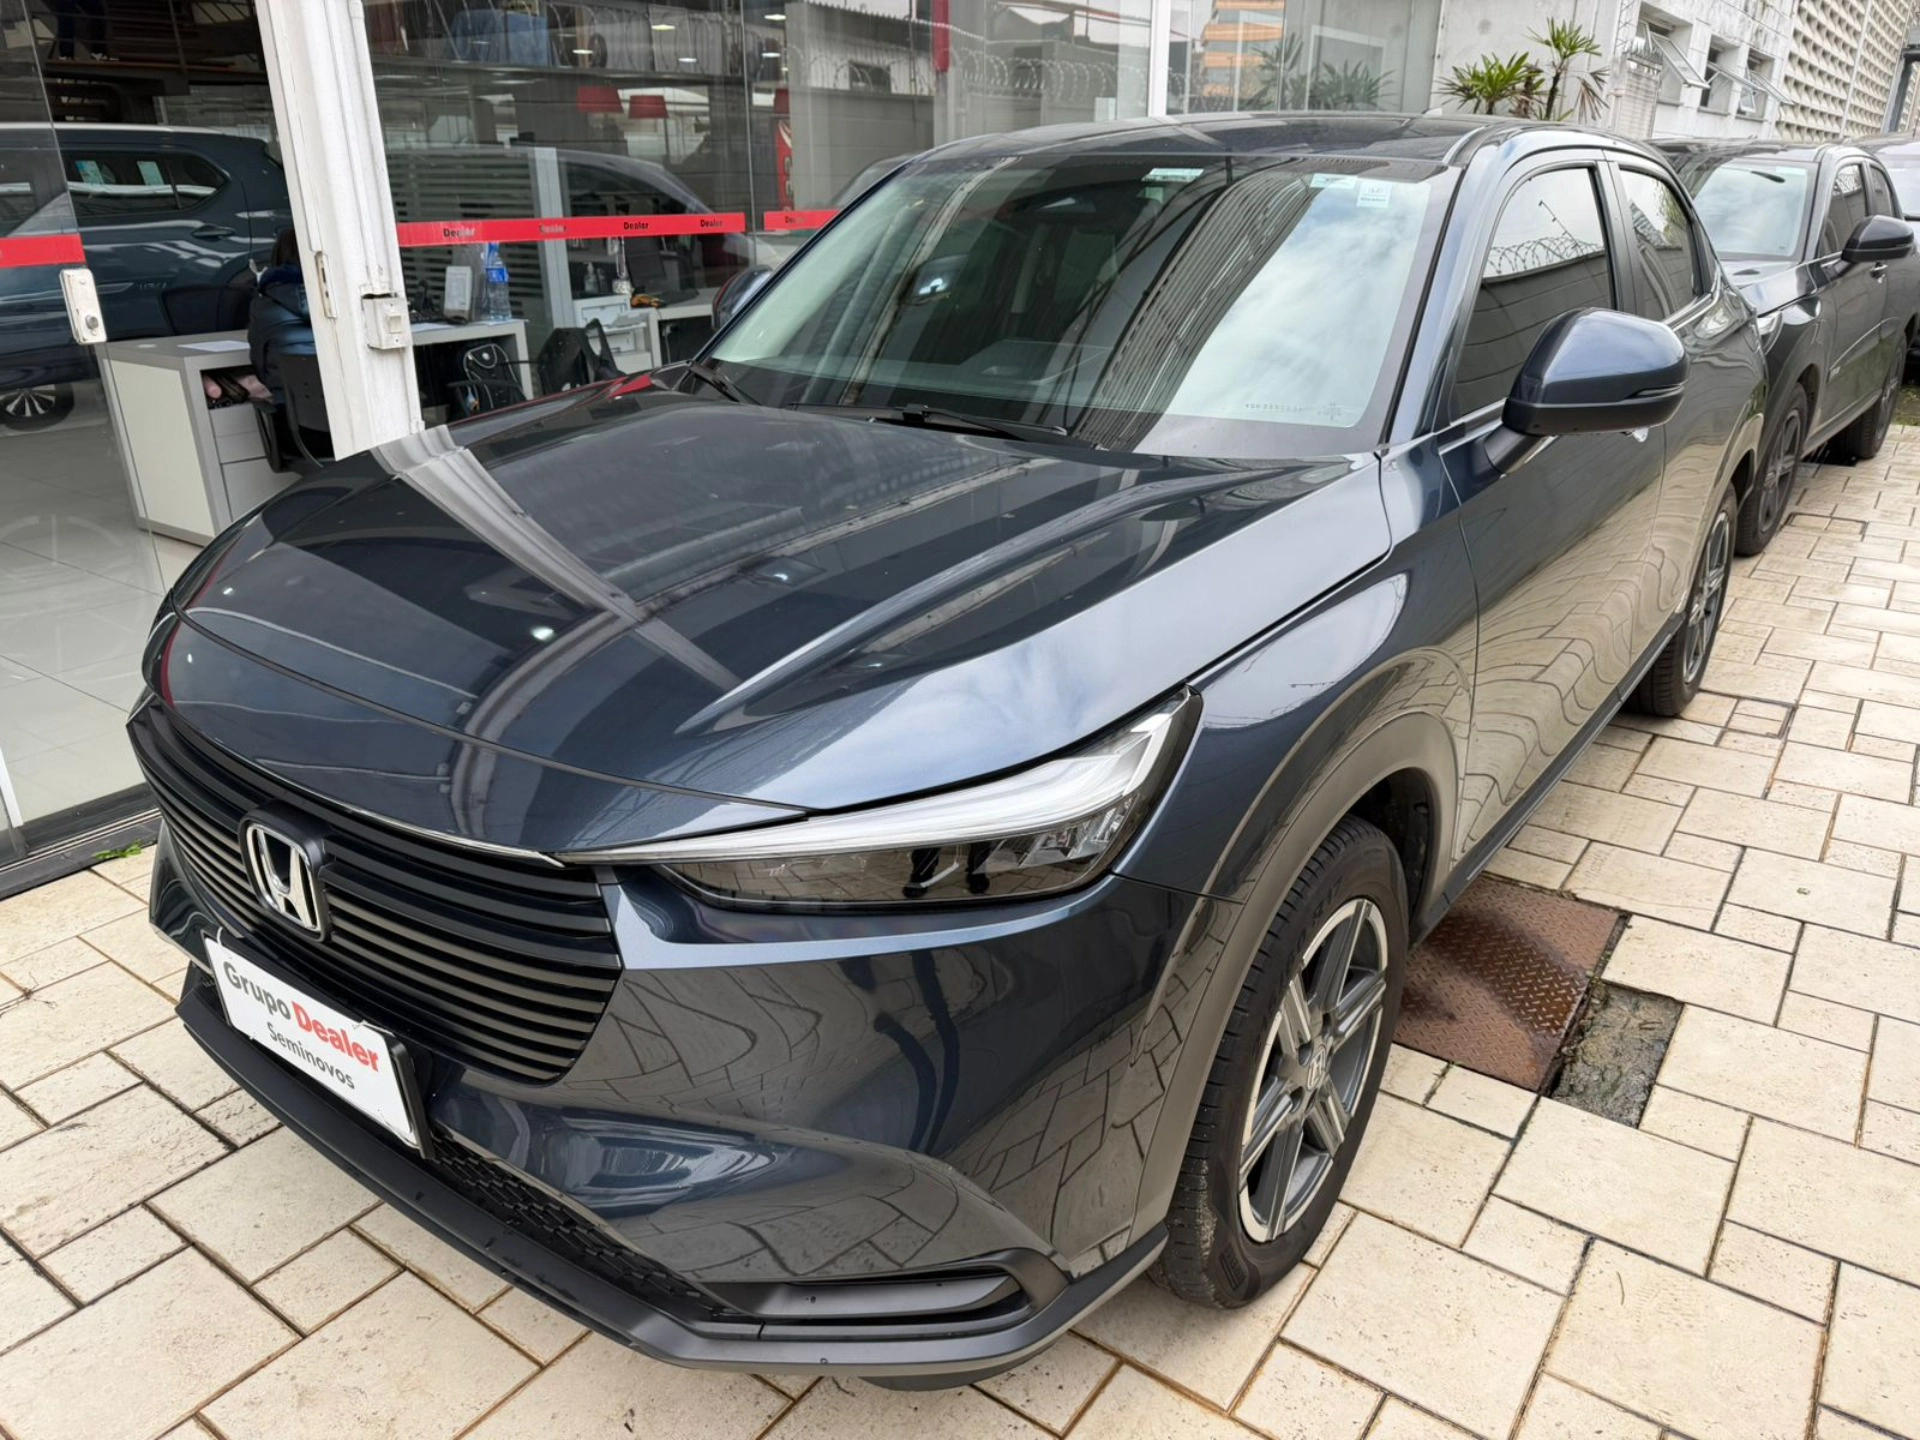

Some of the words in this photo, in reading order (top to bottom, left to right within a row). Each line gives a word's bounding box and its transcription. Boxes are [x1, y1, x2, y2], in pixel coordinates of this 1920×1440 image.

[623, 221, 649, 230] Dealer
[223, 961, 291, 1020] Grupo
[291, 1001, 379, 1072] Dealer
[267, 1022, 355, 1089] Seminovos
